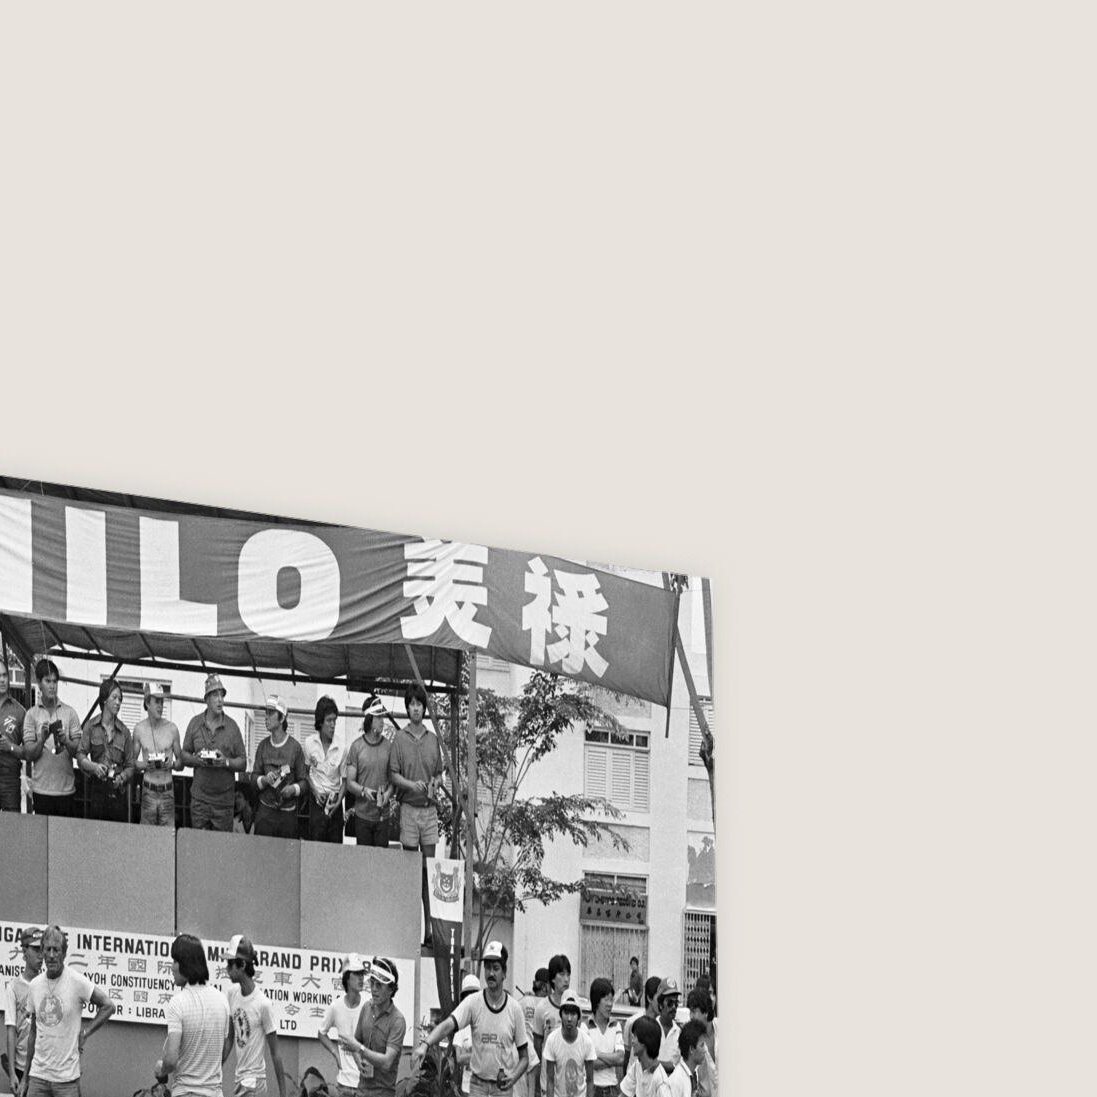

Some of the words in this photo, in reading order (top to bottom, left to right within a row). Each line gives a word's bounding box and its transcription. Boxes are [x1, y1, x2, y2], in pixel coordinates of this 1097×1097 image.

[77, 933, 170, 957] INTERNATIO
[111, 974, 175, 991] CONSTITUENCY
[293, 991, 332, 1005] WORKING
[136, 1006, 166, 1019] LIBRA
[279, 1020, 297, 1031] LTD
